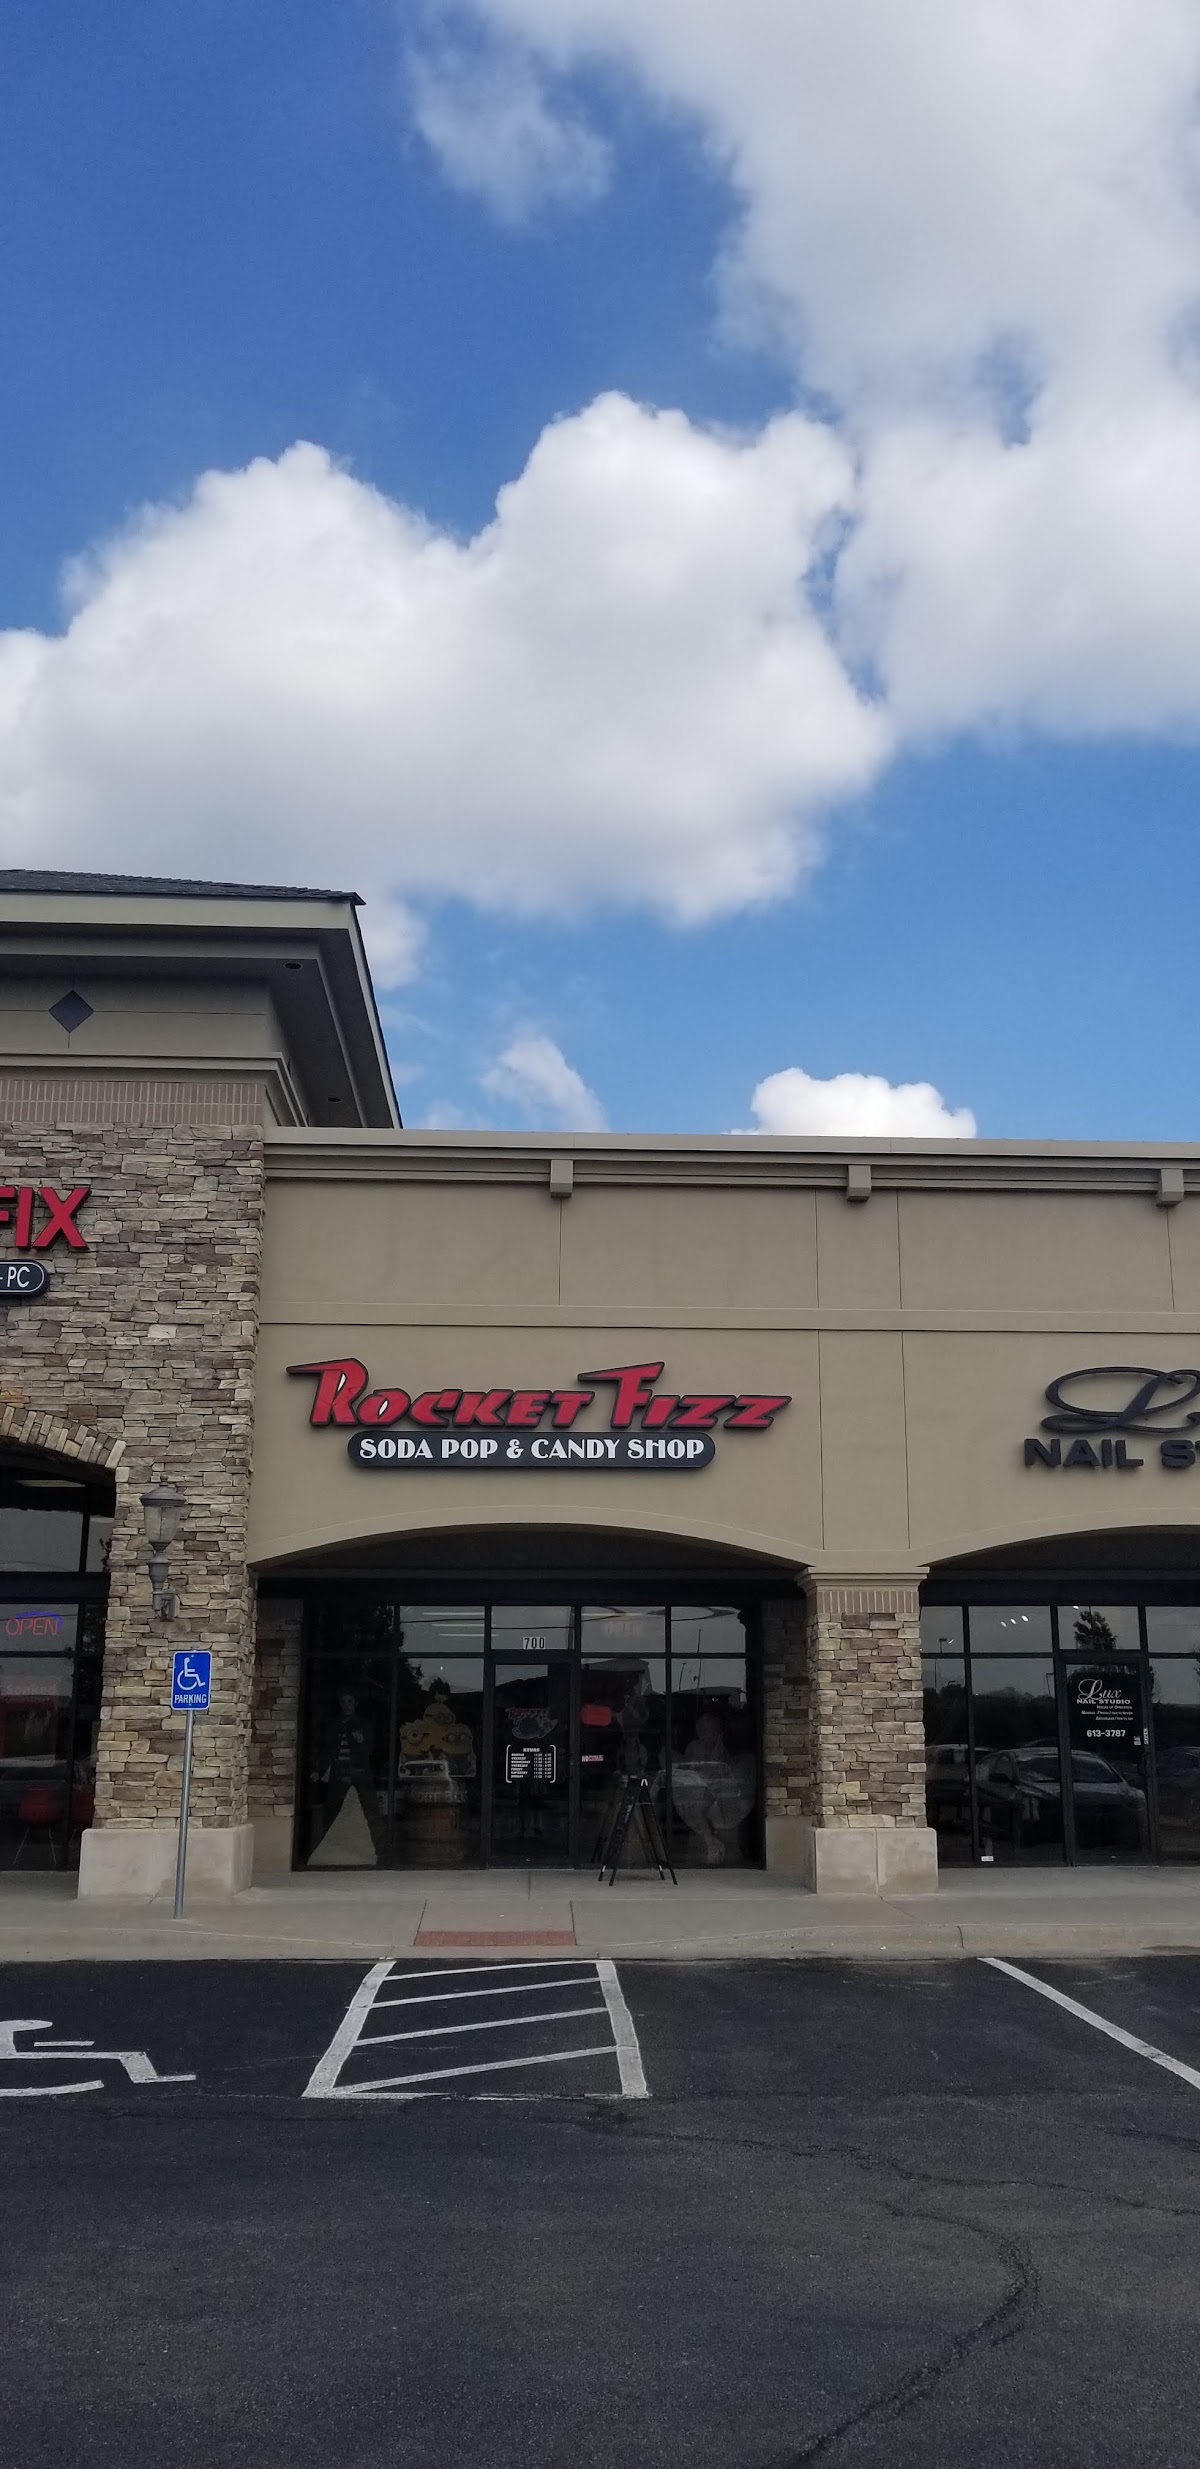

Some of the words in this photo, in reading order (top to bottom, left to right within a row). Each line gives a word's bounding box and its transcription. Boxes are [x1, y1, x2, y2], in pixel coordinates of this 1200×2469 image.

[286, 1357, 595, 1427] ROCKET
[577, 1361, 792, 1428] FIZZ
[359, 1438, 433, 1460] SODA
[441, 1438, 498, 1460] POP
[506, 1438, 524, 1460] &
[531, 1438, 620, 1460] CANDY
[627, 1438, 705, 1459] SHOP
[1024, 1438, 1144, 1469] NAIL
[5, 1616, 58, 1637] OPEN
[523, 1637, 545, 1649] 700
[174, 1693, 208, 1705] PARKING
[1077, 1678, 1122, 1700] Lux
[1086, 1729, 1127, 1738] 613-3787
